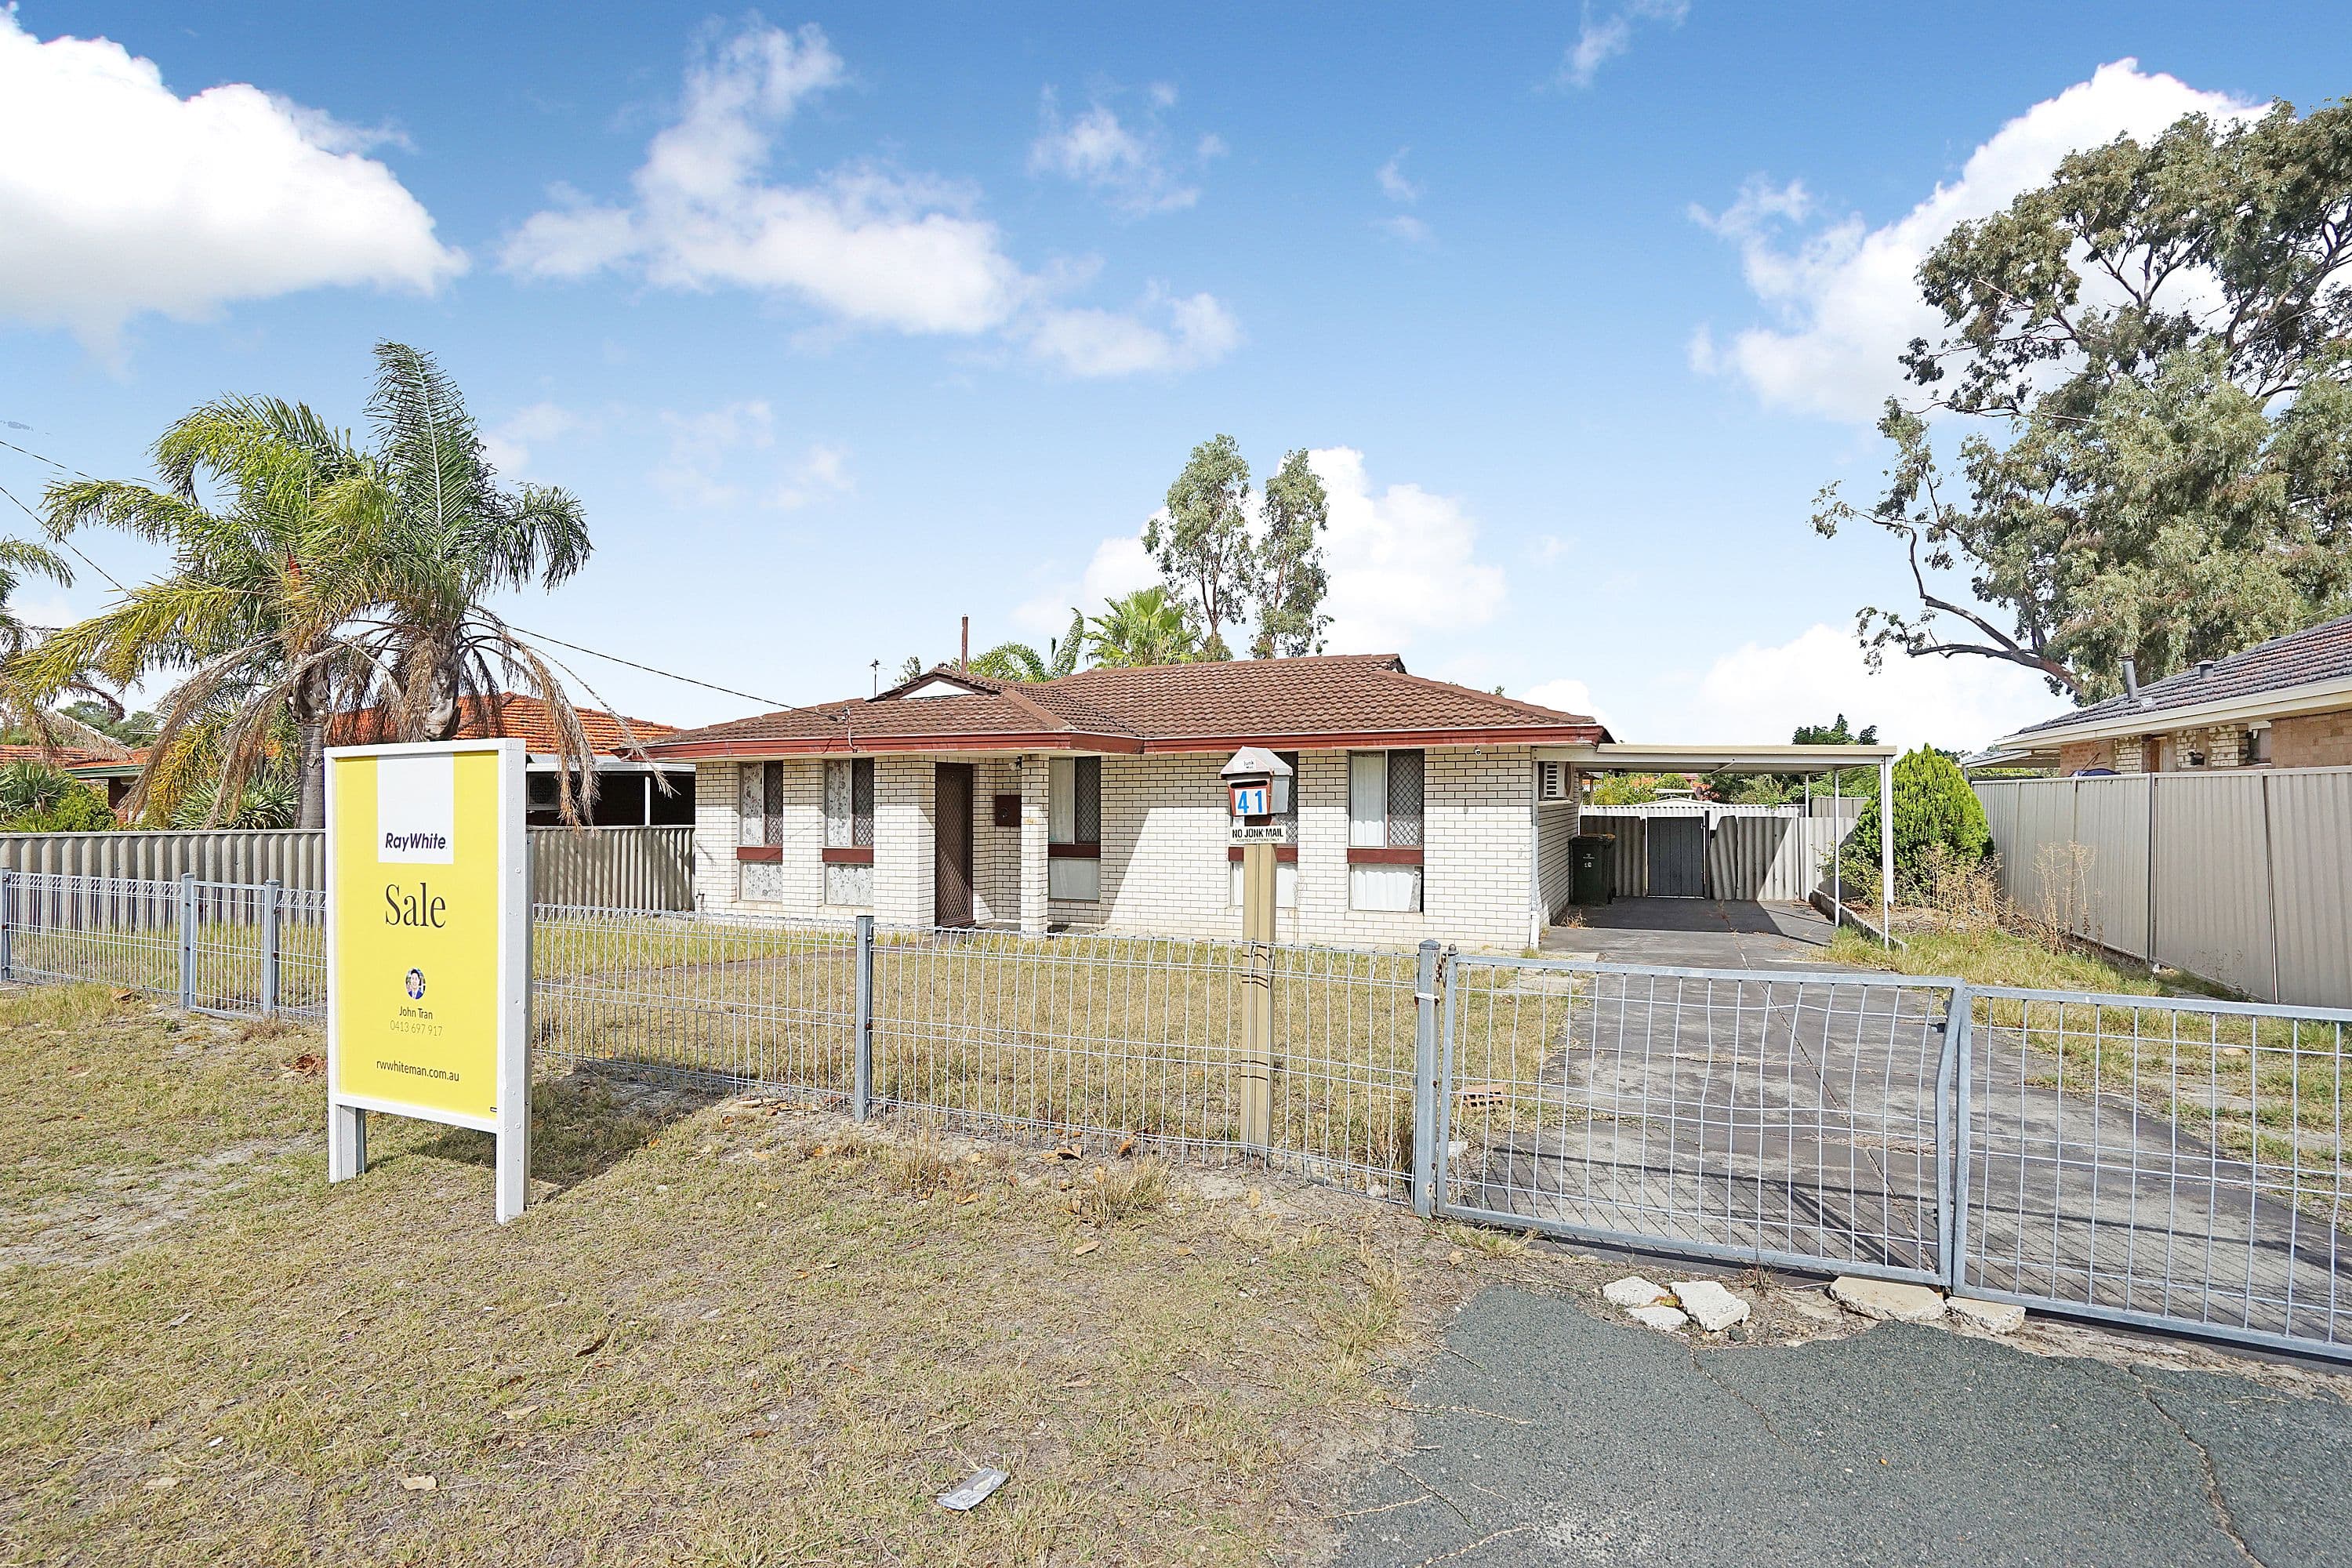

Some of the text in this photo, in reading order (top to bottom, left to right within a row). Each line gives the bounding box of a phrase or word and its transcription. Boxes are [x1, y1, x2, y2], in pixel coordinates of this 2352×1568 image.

[1238, 790, 1263, 814] 41
[1232, 828, 1284, 838] NO JUNK MAIL
[385, 882, 446, 928] Sale
[399, 1006, 434, 1019] John Tran
[390, 1019, 443, 1036] 0413 697 917
[376, 1060, 459, 1082] rwwhiteman.com.au
